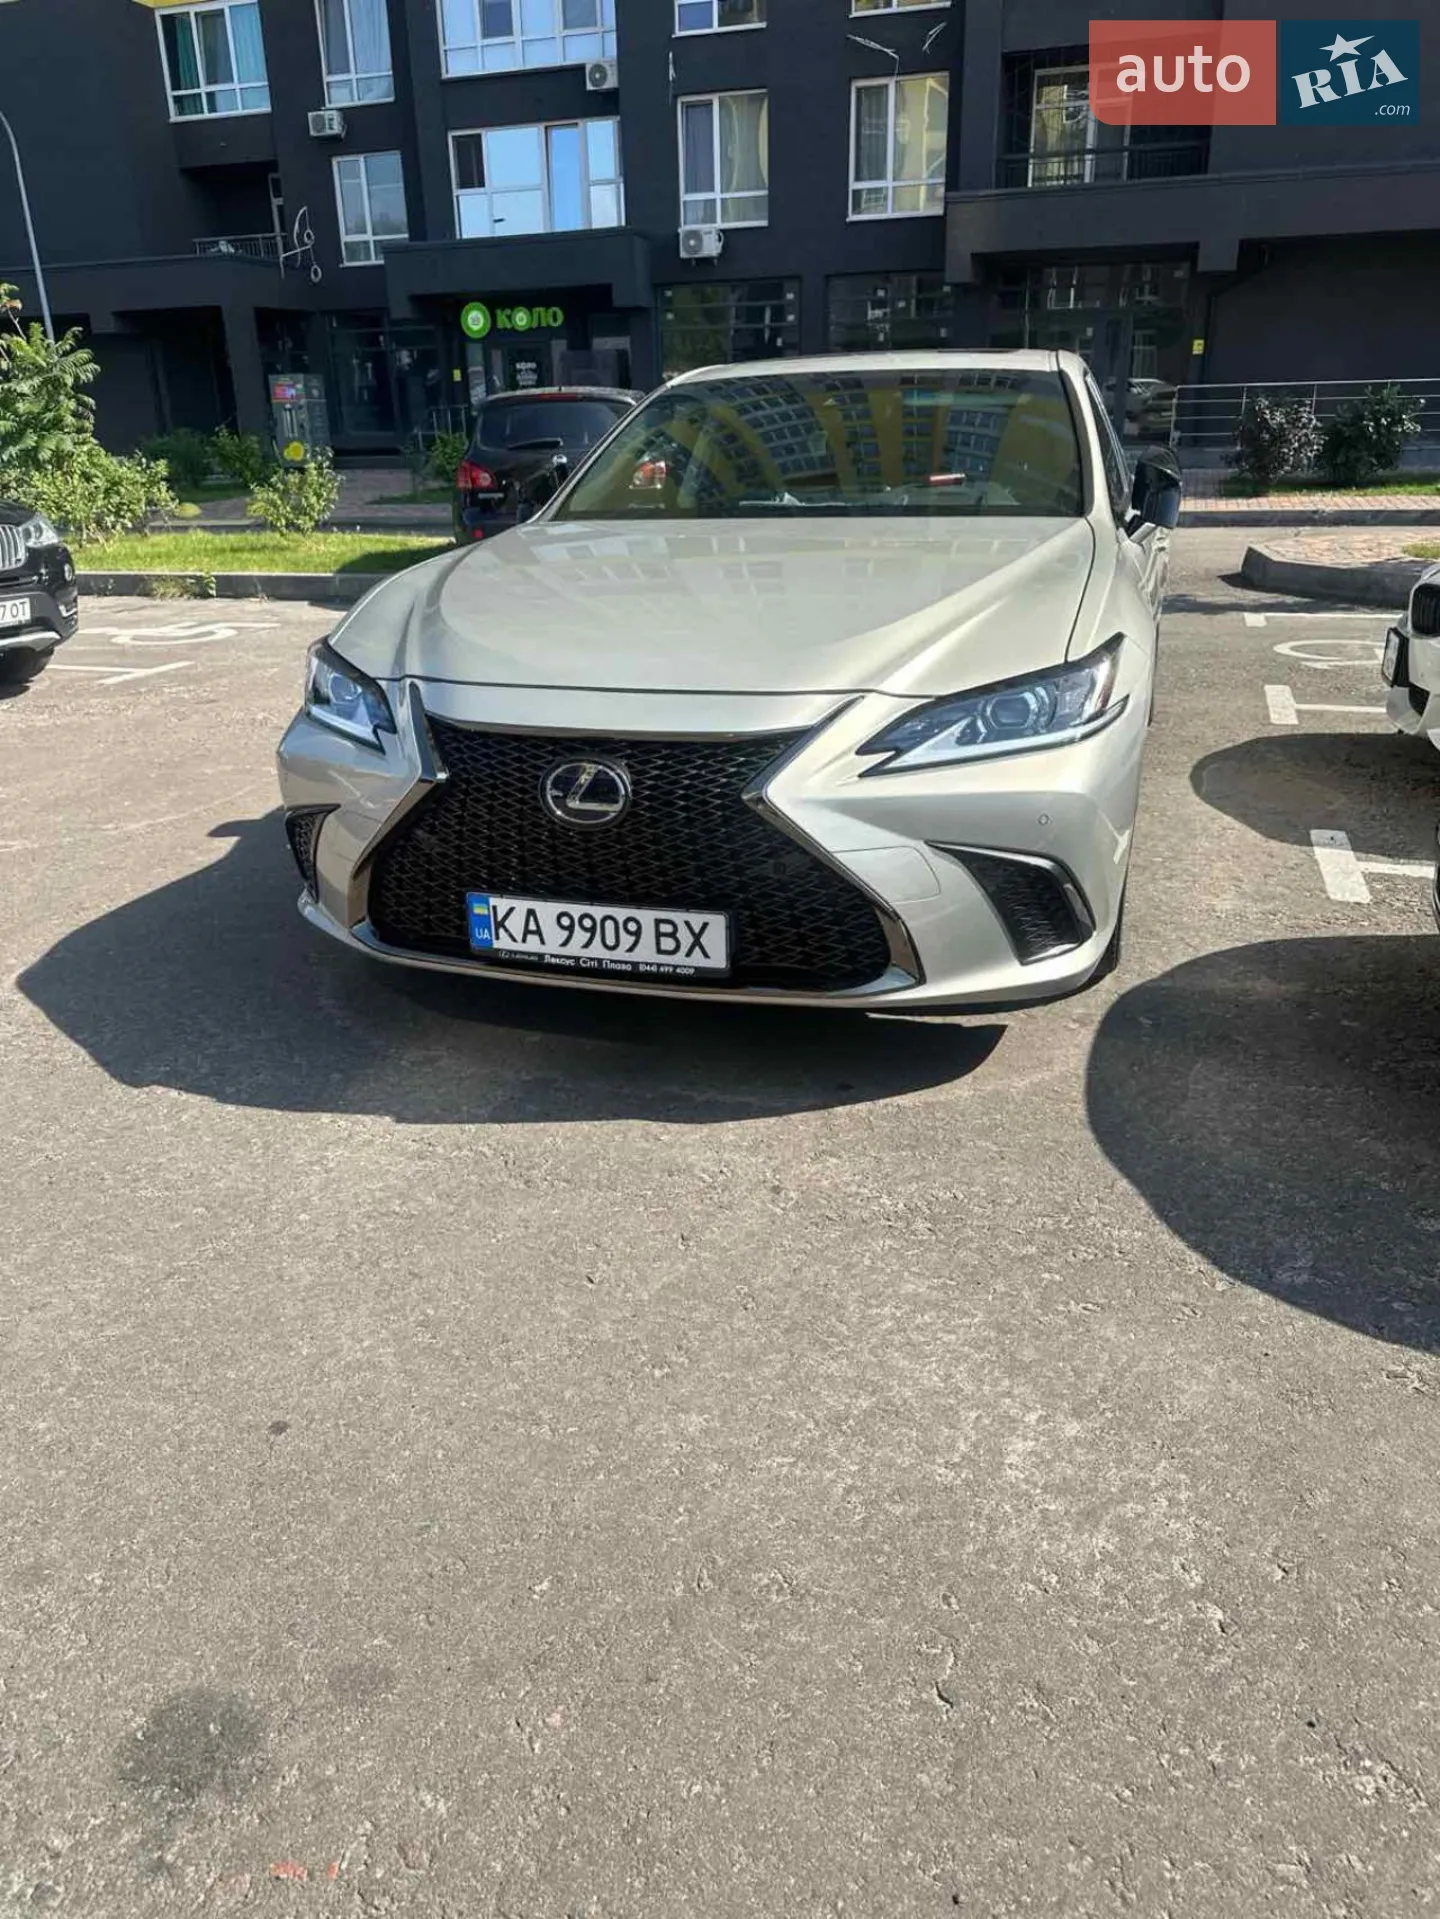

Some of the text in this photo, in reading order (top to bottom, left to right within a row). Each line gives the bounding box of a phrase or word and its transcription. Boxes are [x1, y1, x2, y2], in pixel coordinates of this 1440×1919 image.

[475, 927, 491, 940] UA
[492, 905, 711, 960] KA 9909 BX
